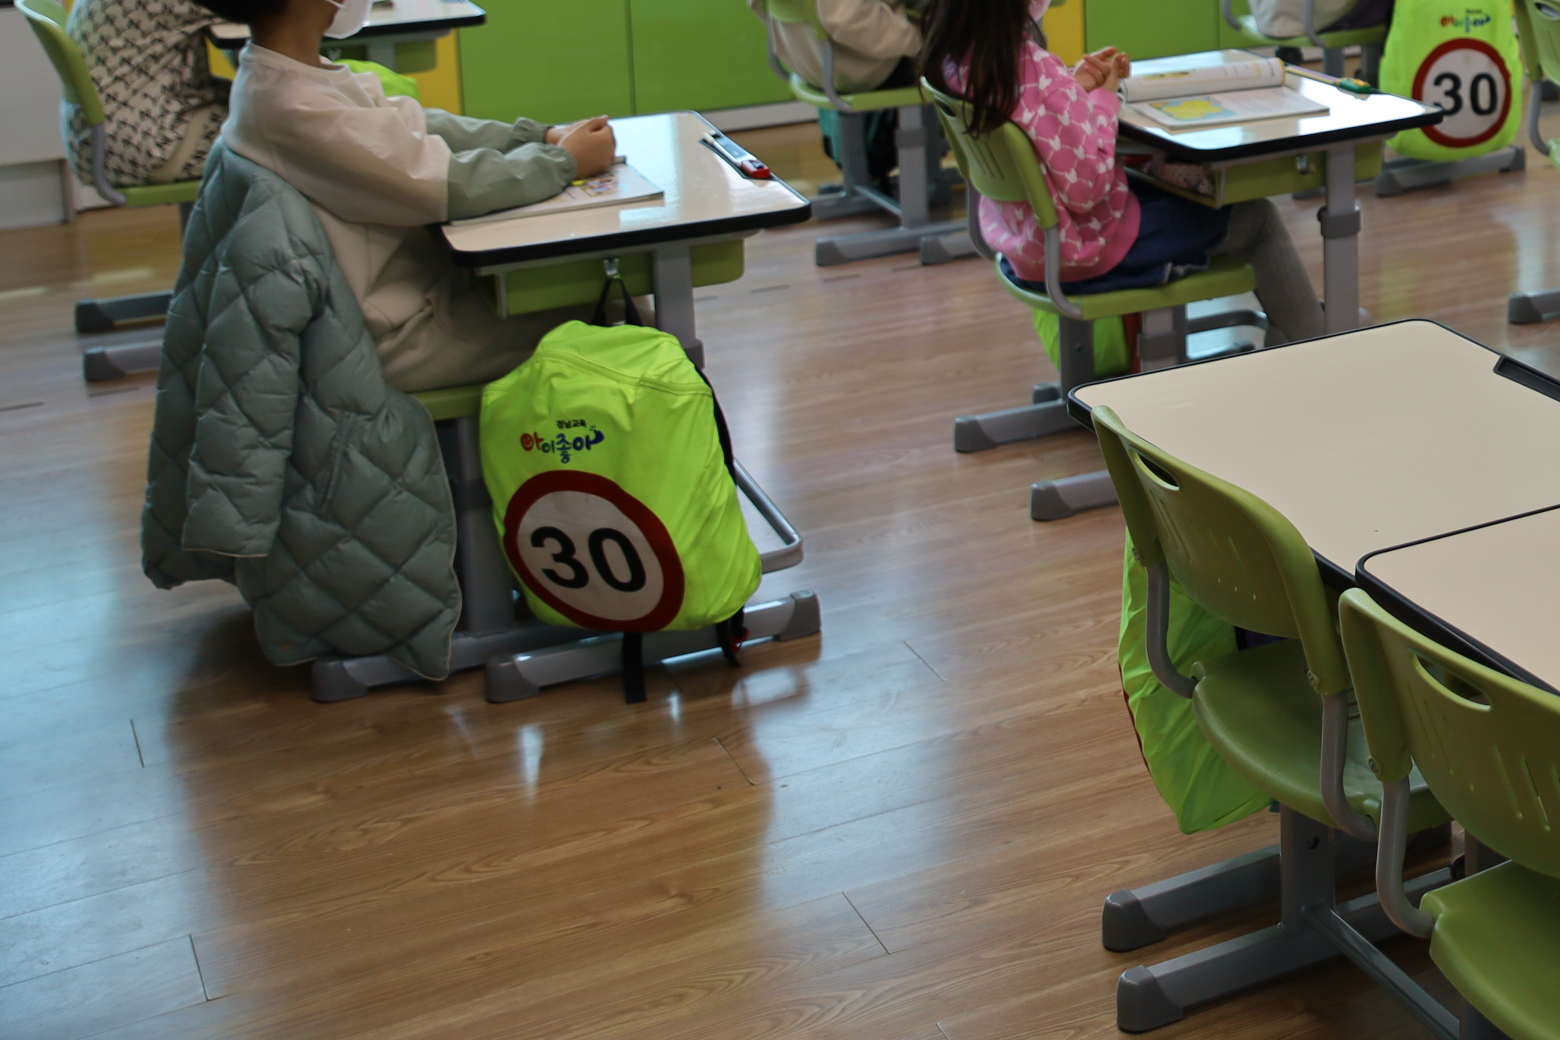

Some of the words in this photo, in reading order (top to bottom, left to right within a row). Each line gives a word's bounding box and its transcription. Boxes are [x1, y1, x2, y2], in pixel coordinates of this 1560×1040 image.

[1433, 72, 1498, 116] 30
[521, 428, 605, 463] 아이좋아
[530, 526, 647, 593] 30
